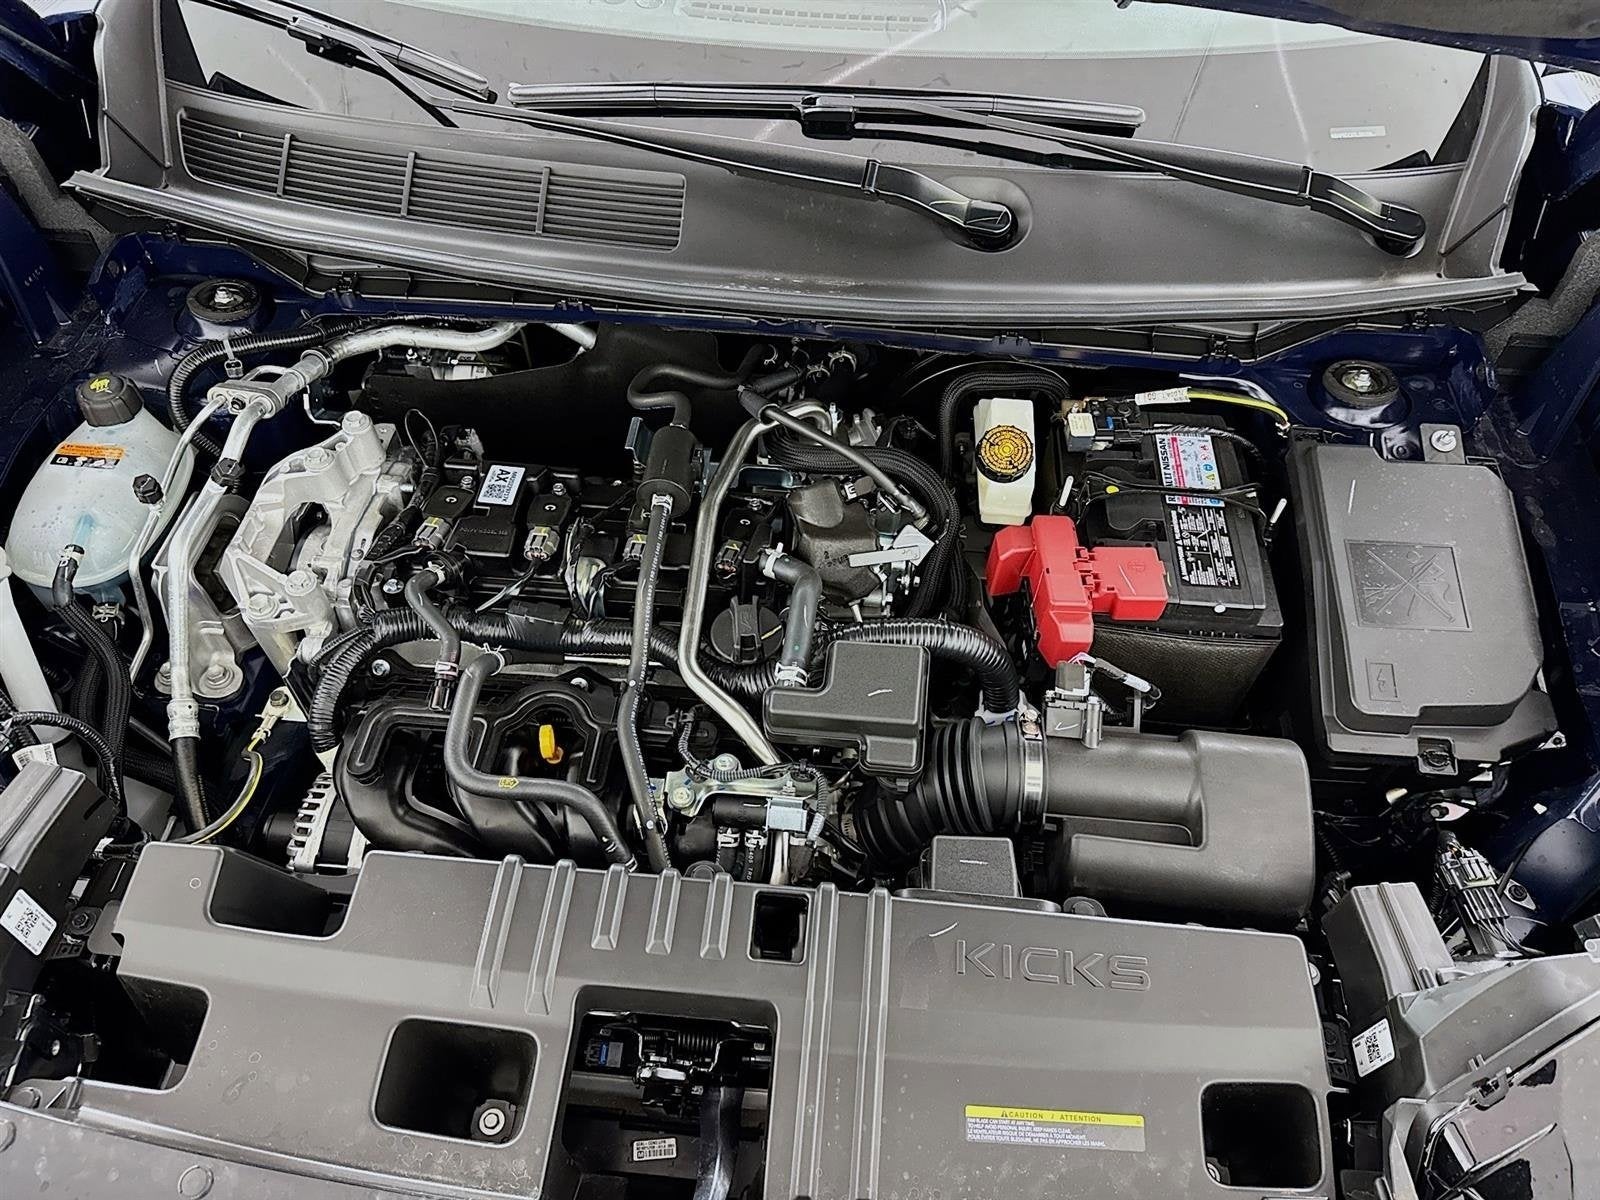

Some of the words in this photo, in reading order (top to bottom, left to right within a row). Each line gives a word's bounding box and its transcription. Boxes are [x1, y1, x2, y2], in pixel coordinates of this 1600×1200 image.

[1159, 438, 1170, 470] NISSAN
[494, 469, 511, 482] AX
[956, 940, 1150, 991] KICKS
[1008, 1111, 1044, 1119] CAUTION
[1059, 1114, 1101, 1122] ATTENTION
